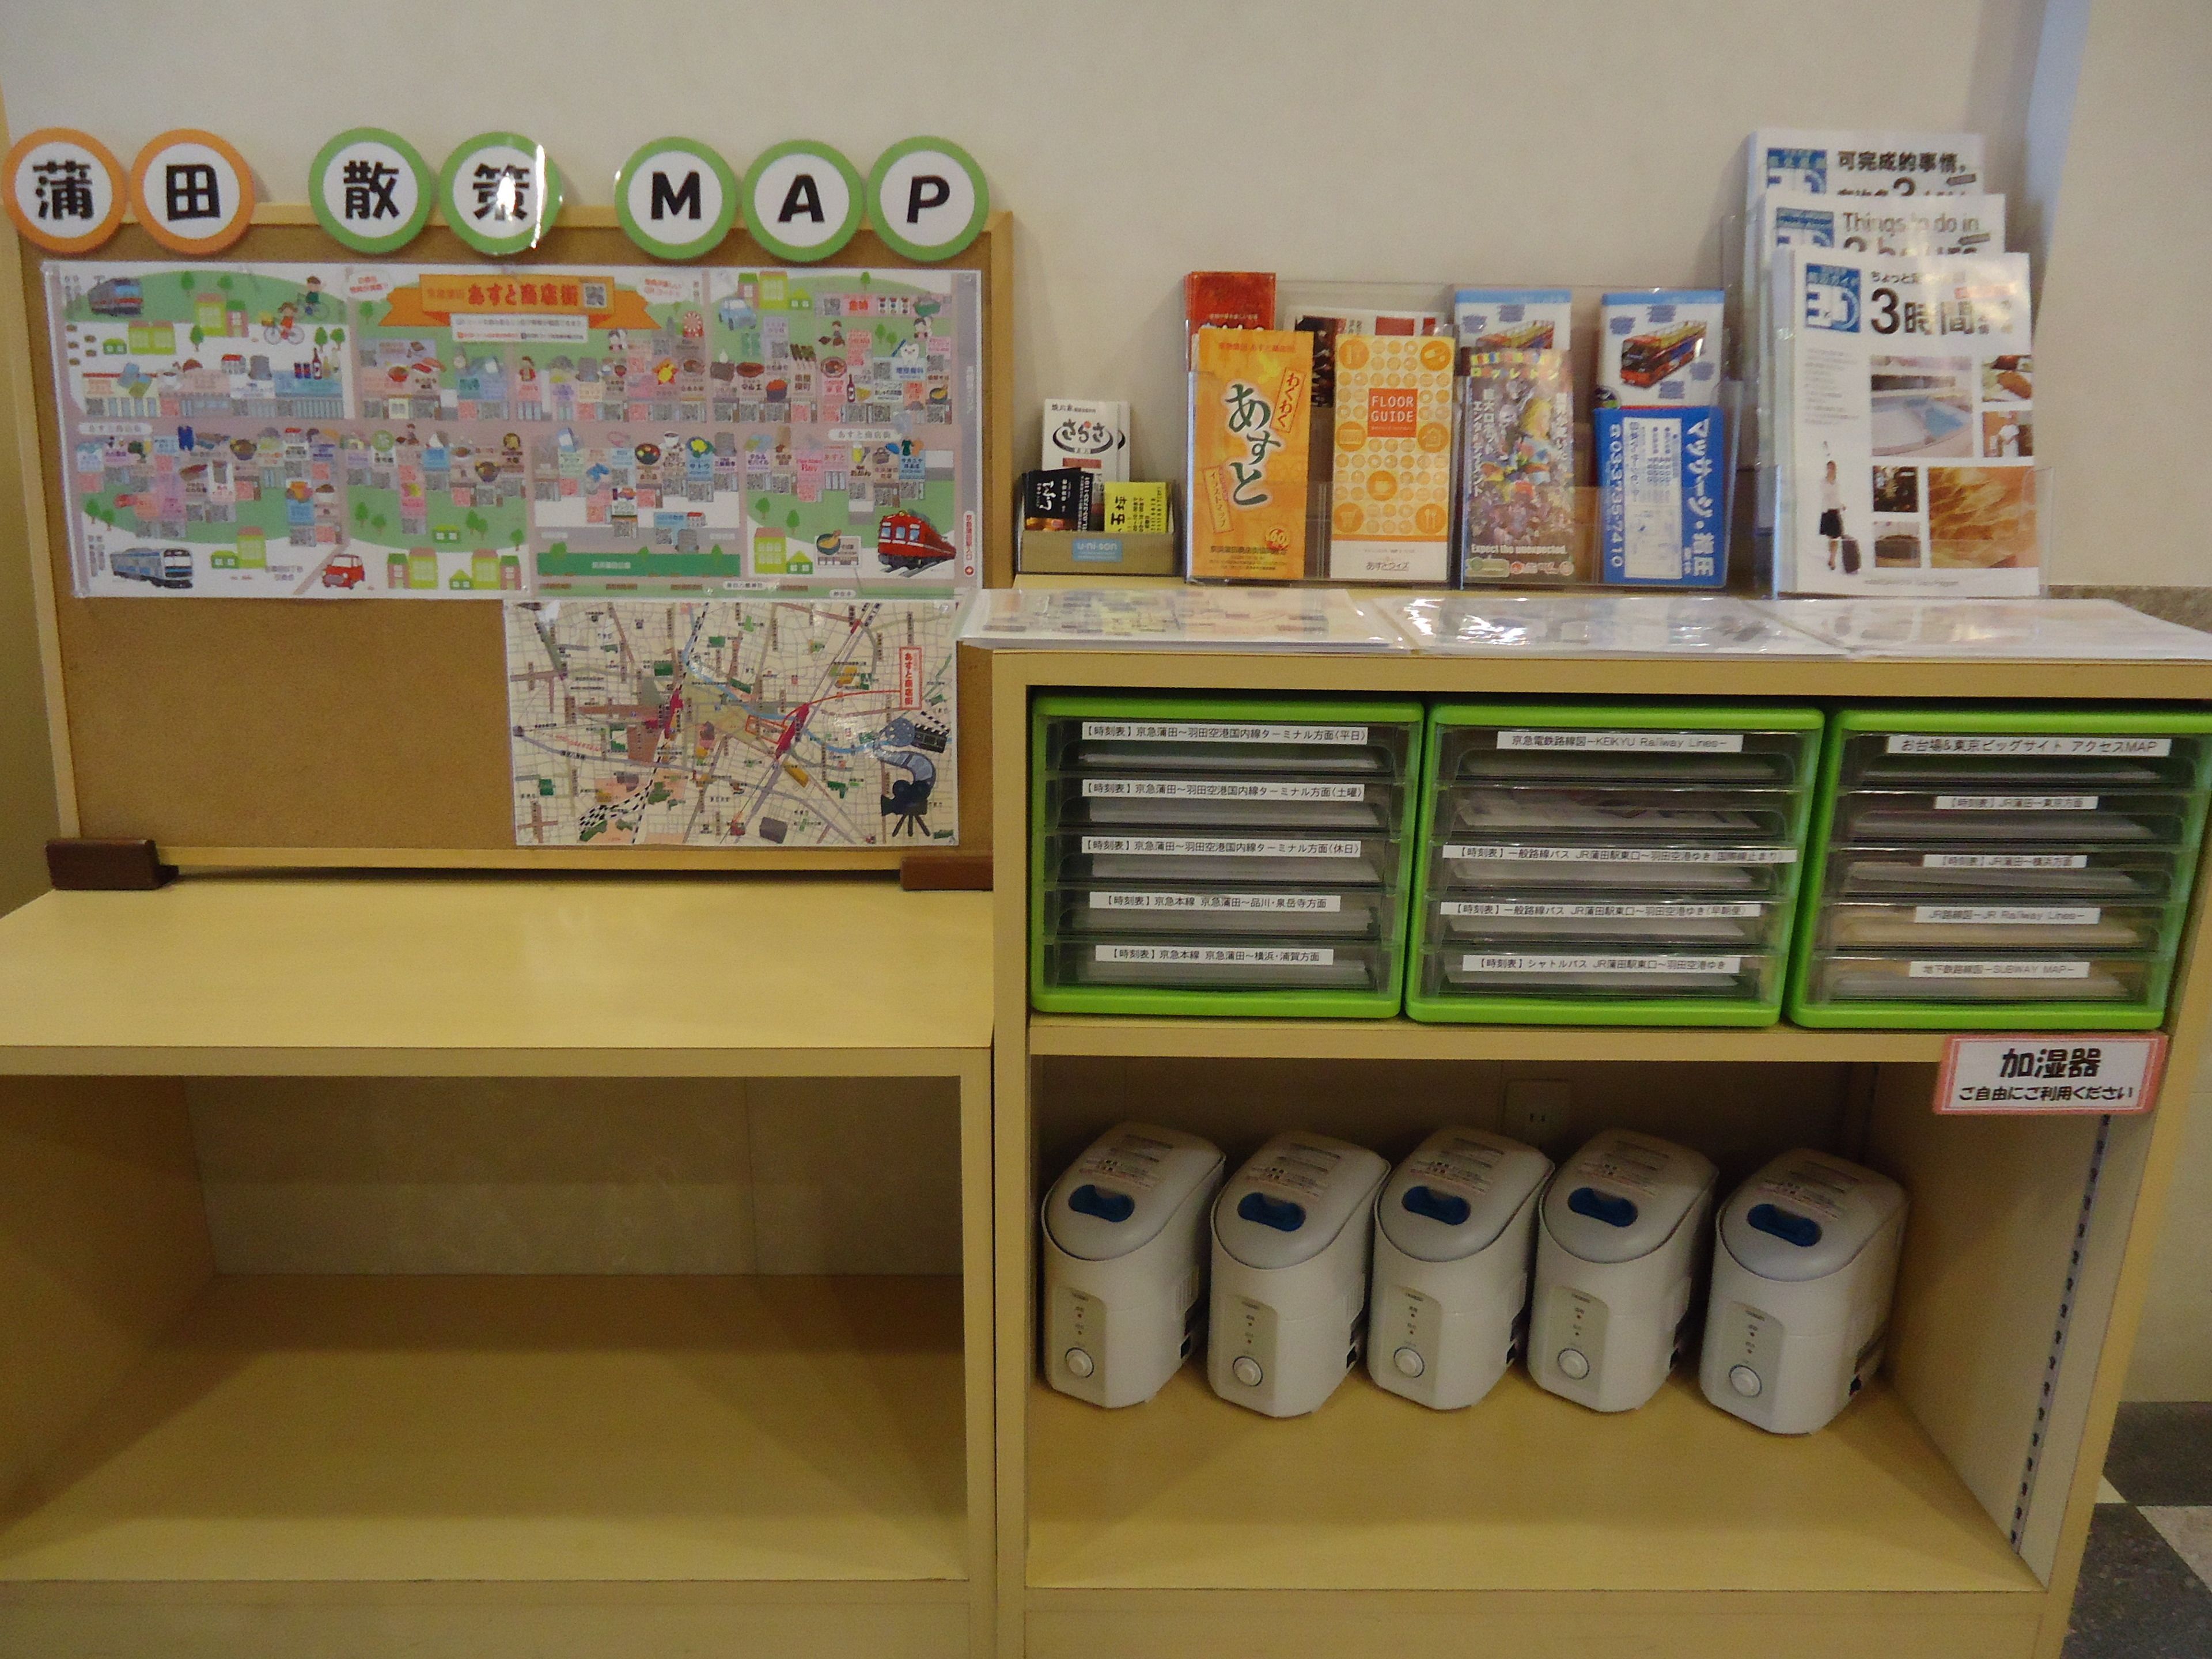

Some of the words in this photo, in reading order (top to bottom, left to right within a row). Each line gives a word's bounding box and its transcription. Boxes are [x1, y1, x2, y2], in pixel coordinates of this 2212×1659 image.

[32, 160, 221, 222] 蒲田
[344, 160, 530, 221] 散策
[651, 171, 950, 224] MAP
[1843, 212, 1906, 236] Things
[1934, 213, 1957, 232] do
[1963, 213, 1979, 232] in
[1276, 371, 1301, 429] わくわく
[1372, 395, 1415, 408] FLOOR
[1370, 410, 1414, 423] GUIDE
[1225, 382, 1282, 507] あすと
[1471, 543, 1499, 555] Expect
[1500, 544, 1514, 554] the
[1999, 1047, 2101, 1078] 加湿器
[1958, 1085, 2133, 1101] ご自由にご利用ください
